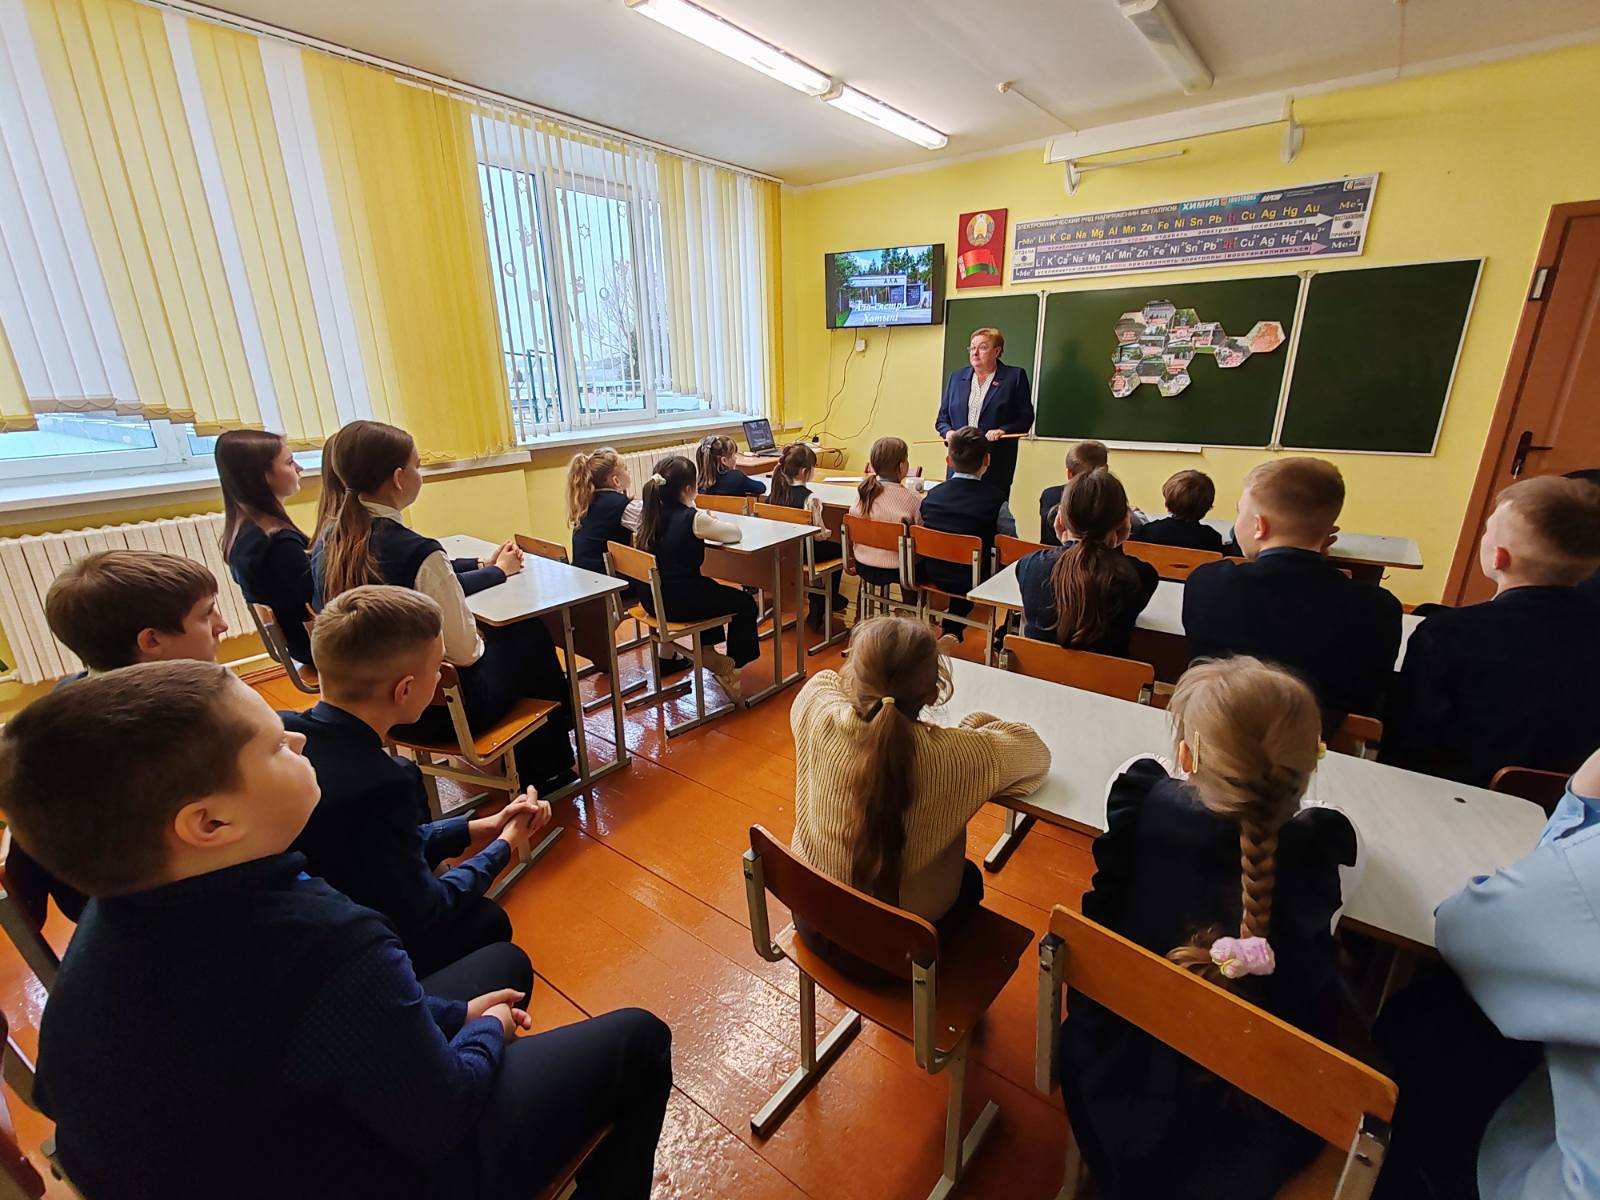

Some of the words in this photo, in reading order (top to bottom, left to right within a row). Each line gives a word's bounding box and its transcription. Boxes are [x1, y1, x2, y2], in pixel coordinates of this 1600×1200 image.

[1183, 200, 1219, 211] ХИМИЯ
[1050, 233, 1057, 242] K
[1061, 232, 1072, 241] Ca
[1076, 230, 1087, 239] Na
[1091, 228, 1104, 239] Mg
[1109, 226, 1118, 235] Al
[1123, 225, 1137, 234] Mn
[1141, 223, 1153, 232] Zn
[1158, 221, 1170, 230] Fe
[1175, 219, 1185, 228] Ni
[1190, 217, 1204, 226] Sn
[1209, 215, 1223, 224] Pb
[1241, 210, 1256, 220] Cu
[1261, 208, 1277, 220] Ag
[1282, 205, 1299, 217] Hg
[1304, 203, 1321, 213] Au
